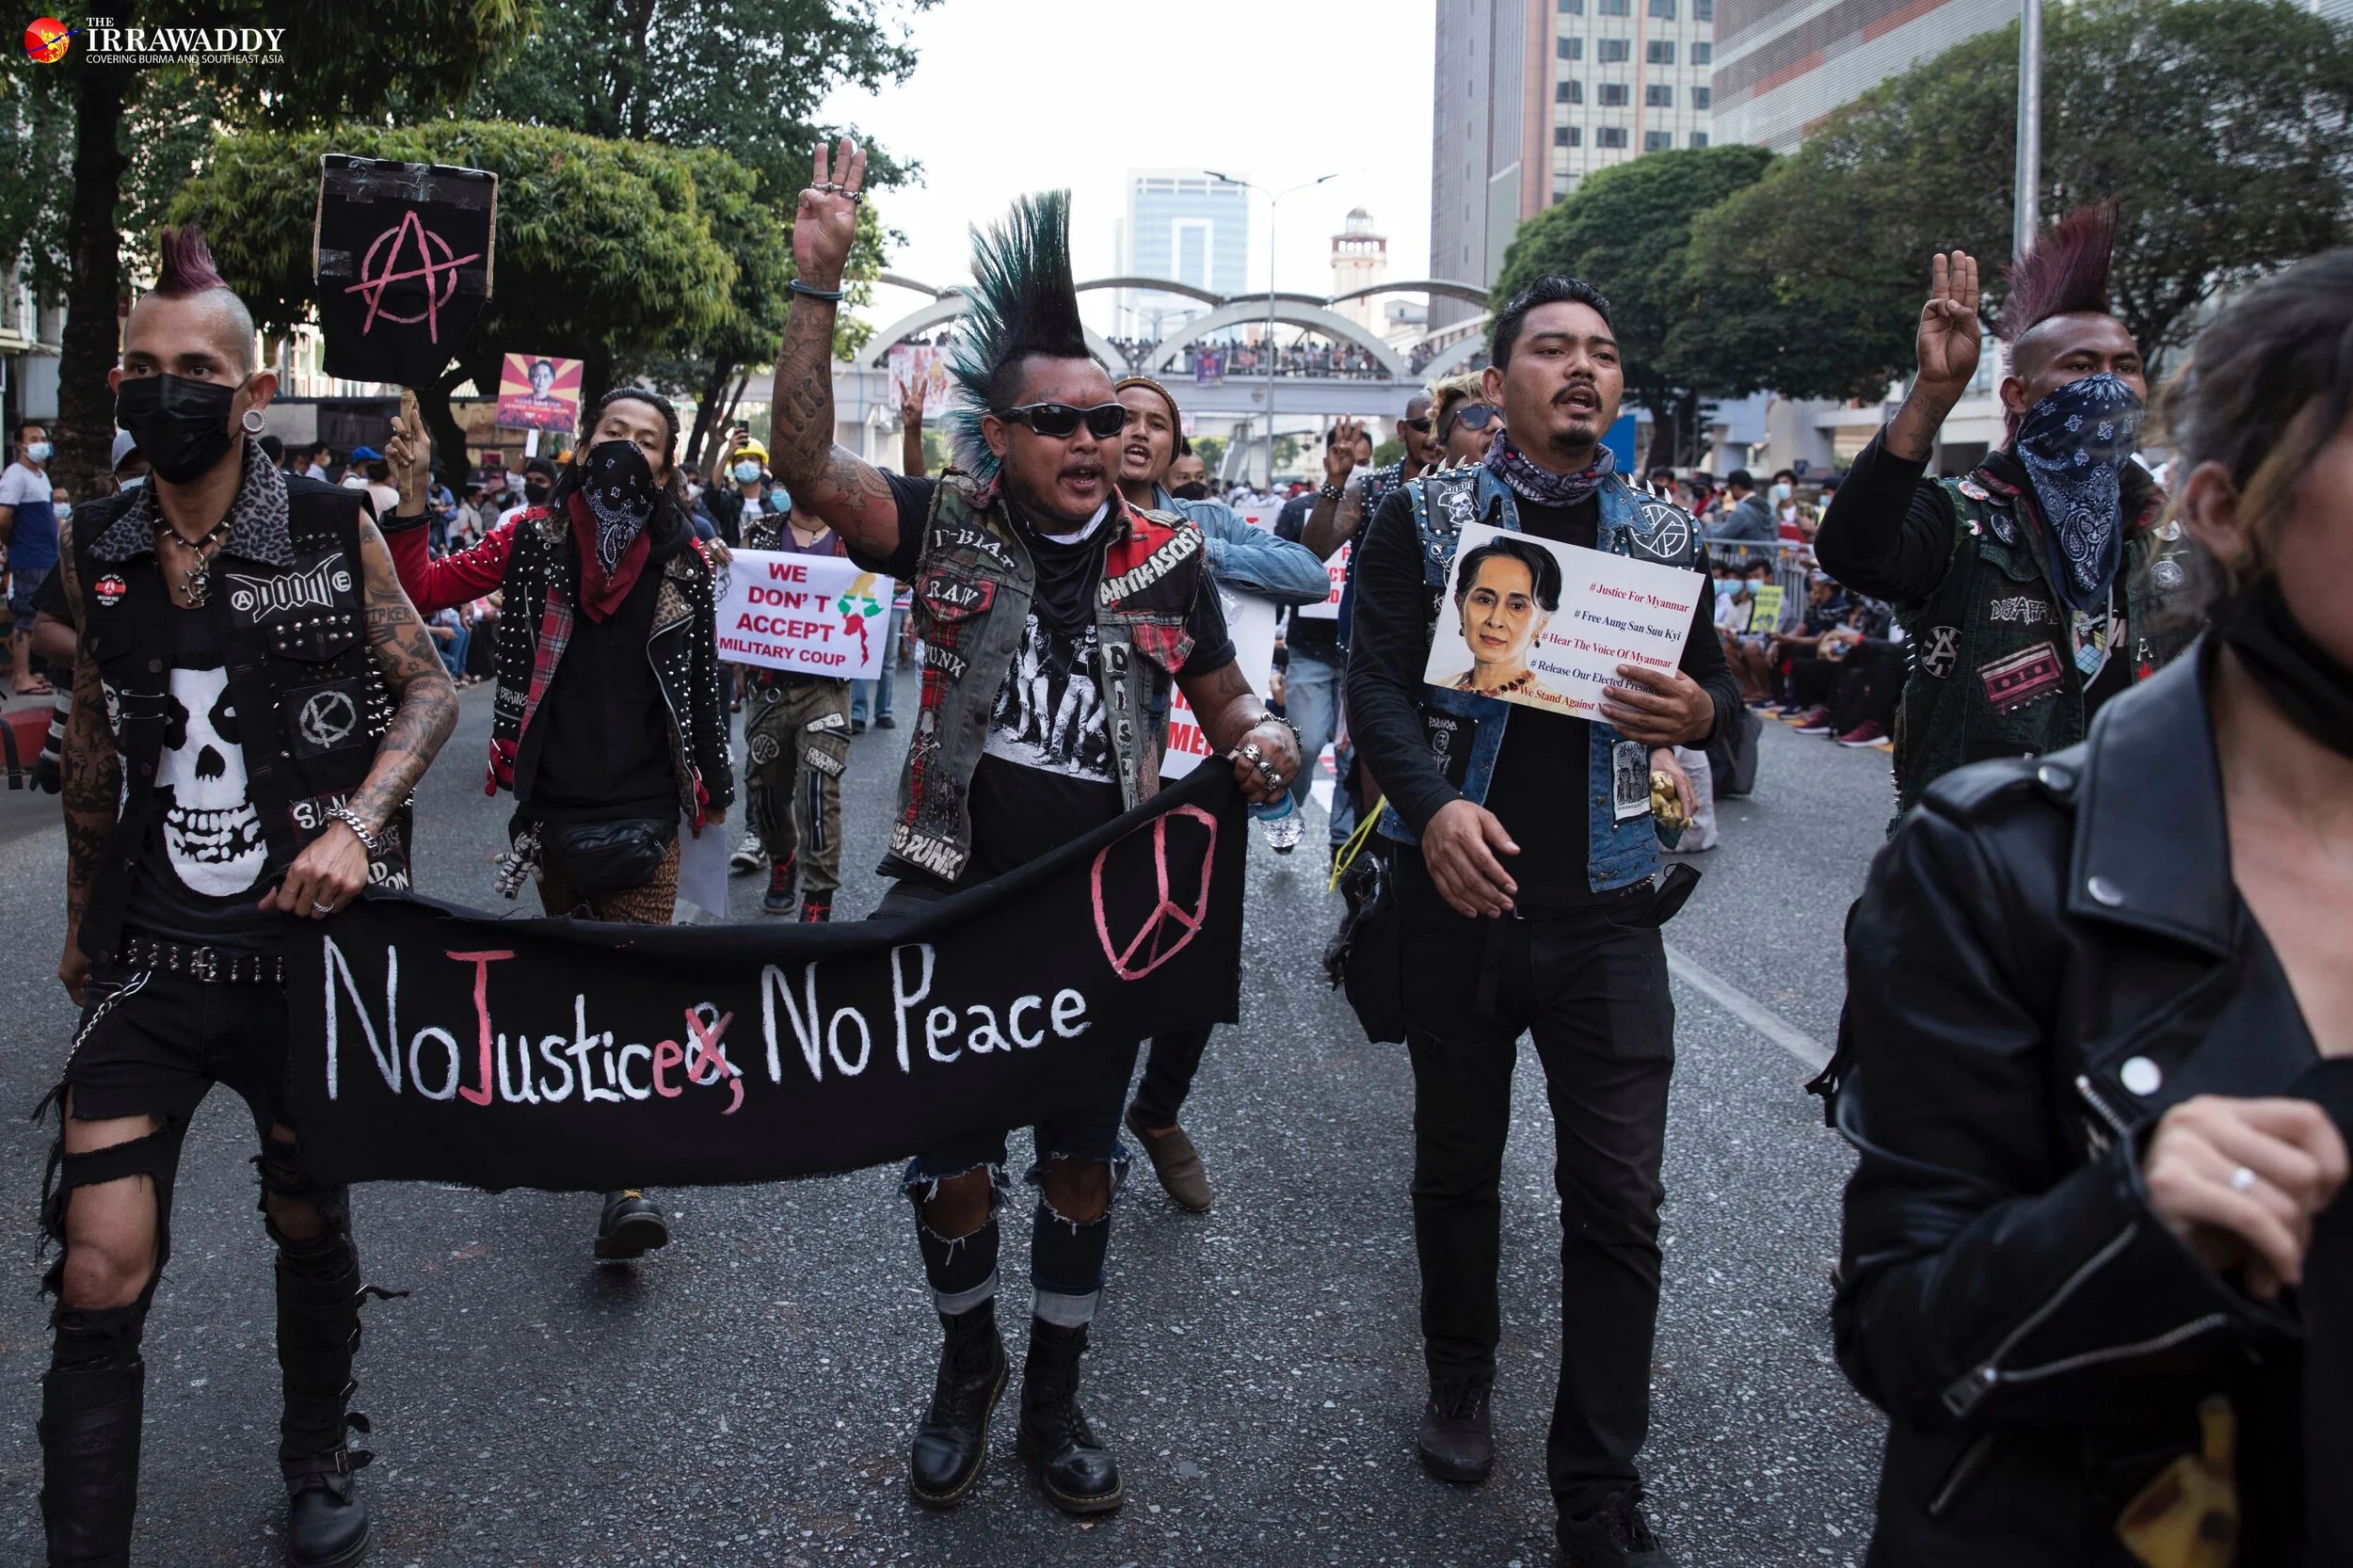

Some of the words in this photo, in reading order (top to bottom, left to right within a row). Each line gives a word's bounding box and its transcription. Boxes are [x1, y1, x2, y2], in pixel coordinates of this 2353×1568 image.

[769, 563, 808, 583] WE
[1100, 527, 1203, 604] ANTIFASCIST
[926, 581, 979, 606] RAW
[1628, 590, 1644, 603] For
[1645, 595, 1690, 613] Myanmar
[736, 613, 835, 642] ACCEPT
[1602, 616, 1627, 632] Aung
[1627, 621, 1644, 633] San
[1645, 625, 1663, 637] Suu
[1665, 628, 1682, 642] Kyi
[719, 637, 795, 660] MILITARY
[799, 649, 846, 666] COUP
[1574, 638, 1591, 651] The
[1593, 643, 1615, 657] Voice
[1616, 648, 1629, 660] Of
[1630, 650, 1673, 668] Myanmar
[1572, 667, 1591, 680] Our
[1592, 672, 1625, 688] Elected
[1520, 685, 1534, 697] We
[1535, 690, 1561, 704] Stand
[1561, 696, 1594, 711] Against
[902, 834, 964, 880] PUNK
[323, 935, 460, 1101] No
[760, 961, 871, 1083] No
[891, 943, 1092, 1075] Peace
